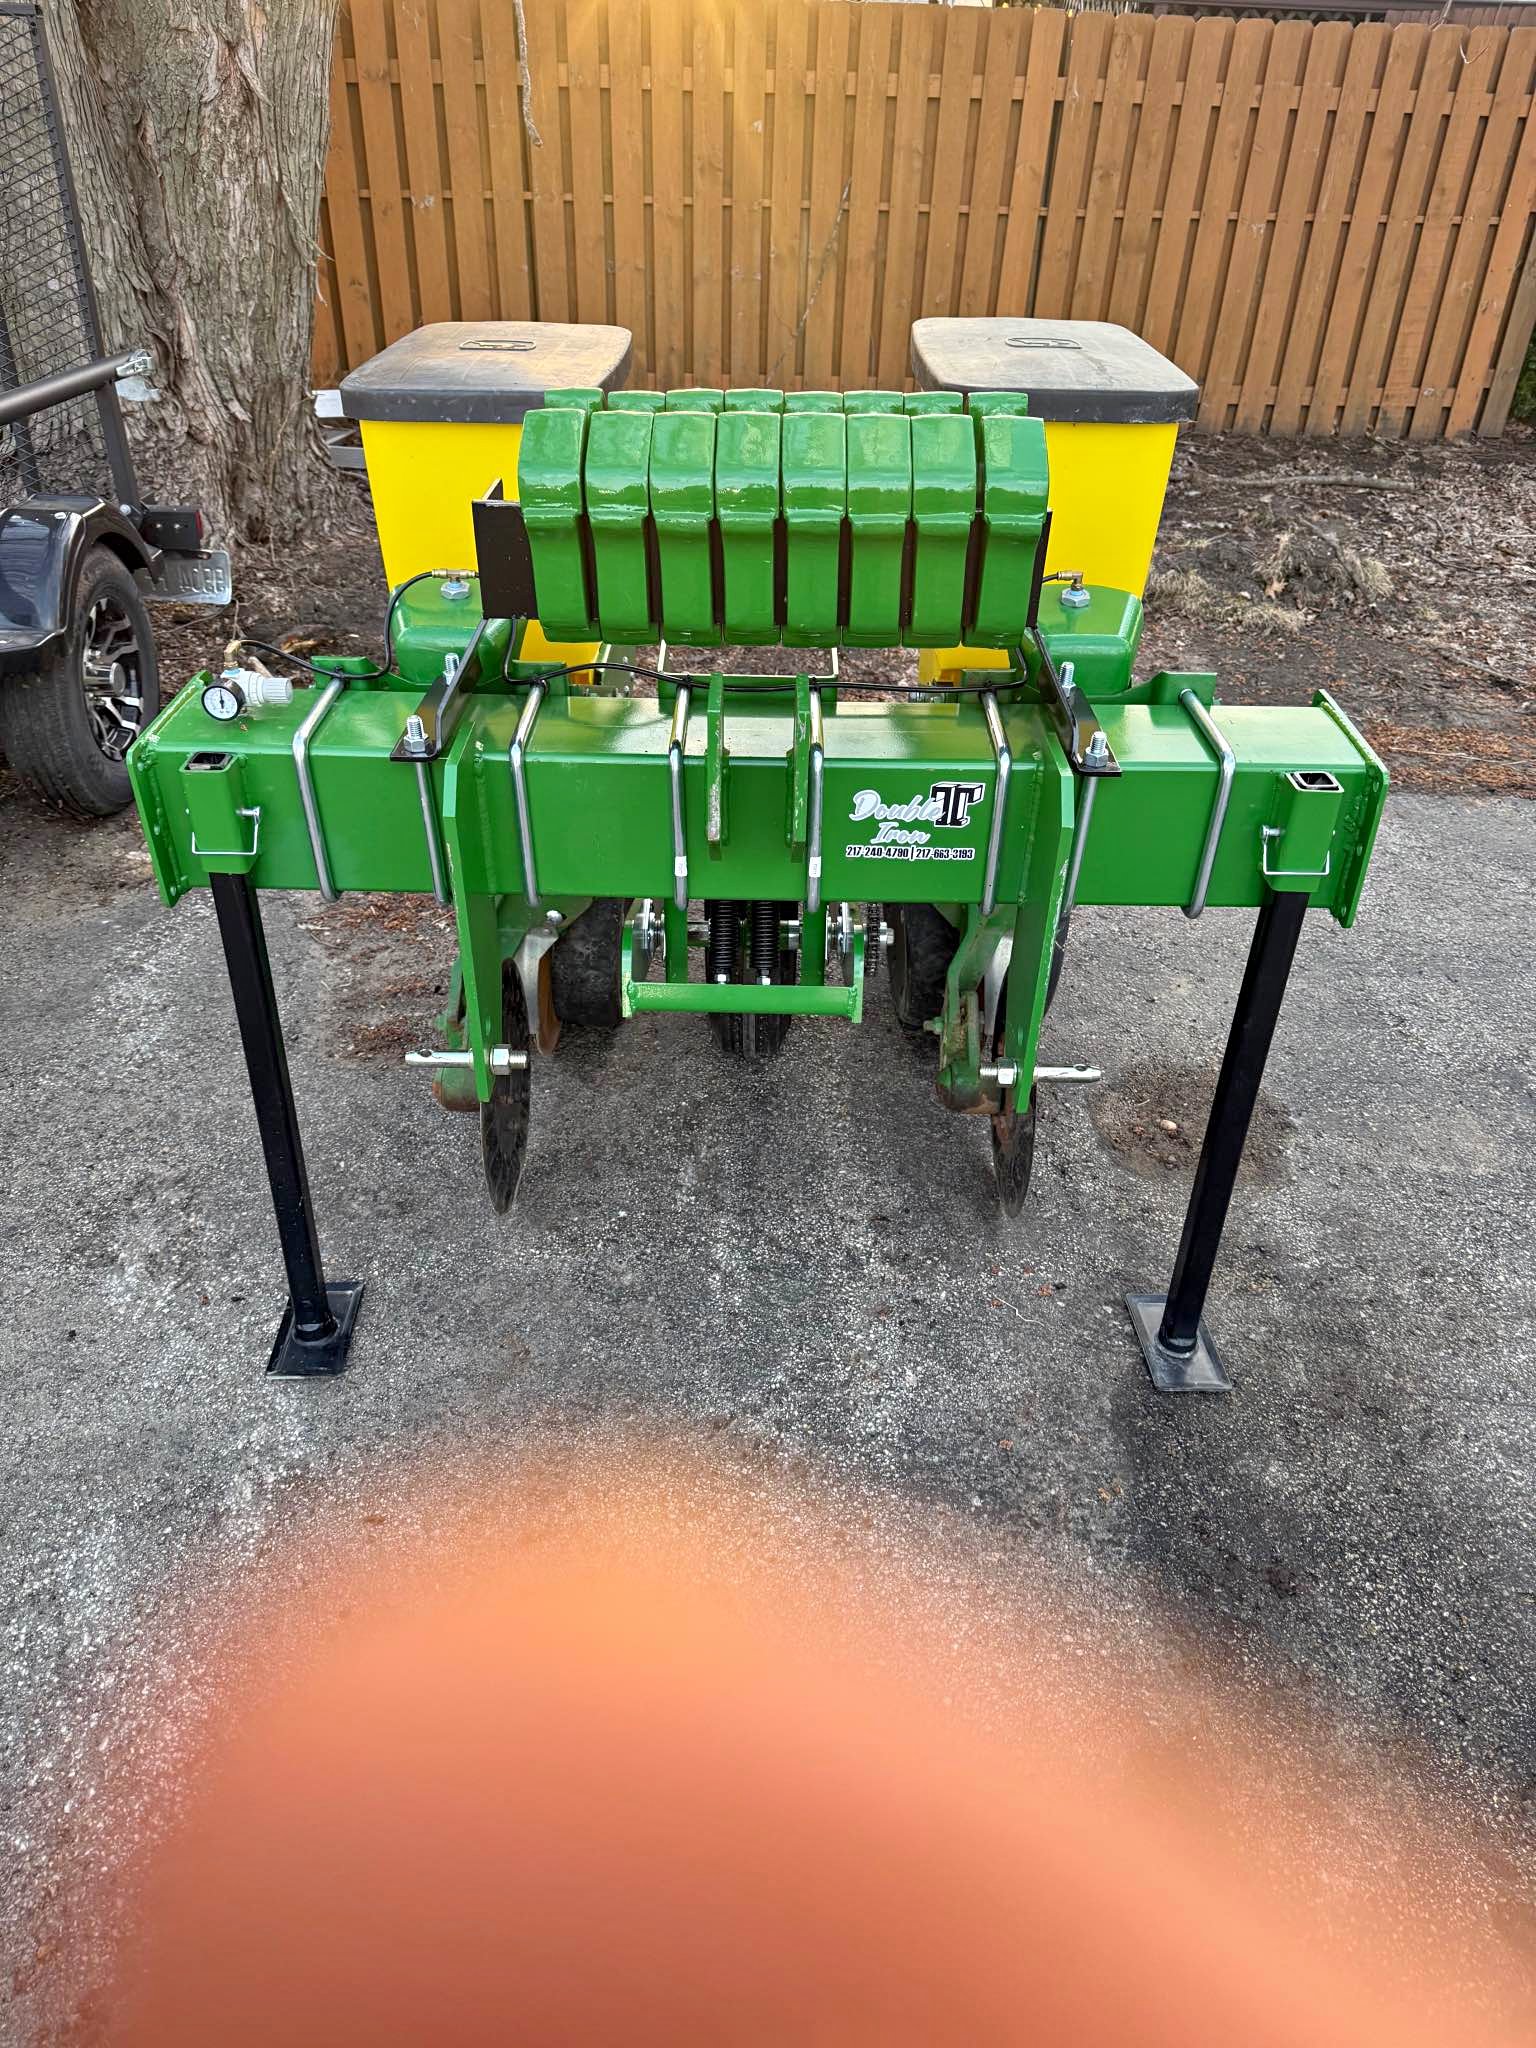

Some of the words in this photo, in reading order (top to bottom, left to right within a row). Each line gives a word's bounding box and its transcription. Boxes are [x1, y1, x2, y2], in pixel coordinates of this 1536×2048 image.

[850, 790, 945, 822] Double
[870, 822, 931, 844] Iron
[916, 848, 973, 859] 217-663-3193
